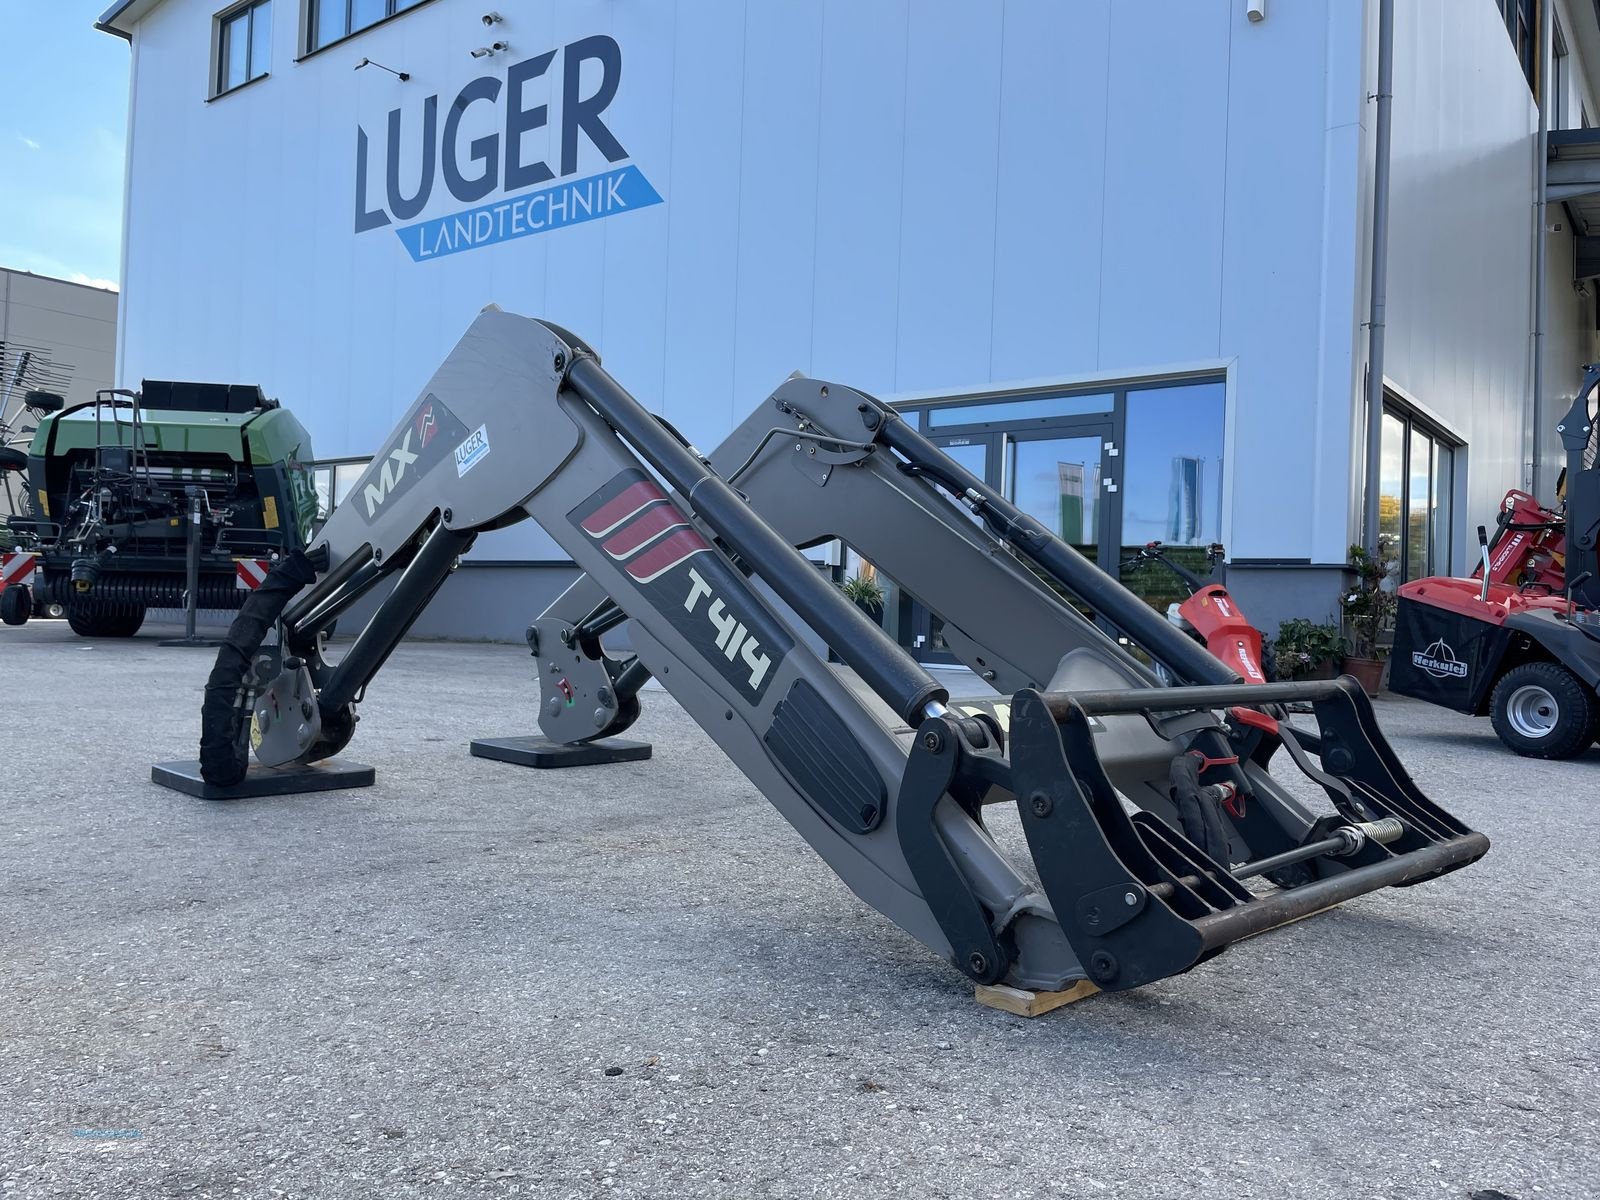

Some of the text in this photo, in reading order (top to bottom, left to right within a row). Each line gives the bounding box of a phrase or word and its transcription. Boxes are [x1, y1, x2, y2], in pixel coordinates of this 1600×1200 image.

[355, 35, 630, 234] LUGER
[419, 174, 627, 257] LANDTECHNIK
[363, 427, 419, 518] MX
[455, 430, 484, 465] LUGER
[1414, 654, 1465, 675] Herkules
